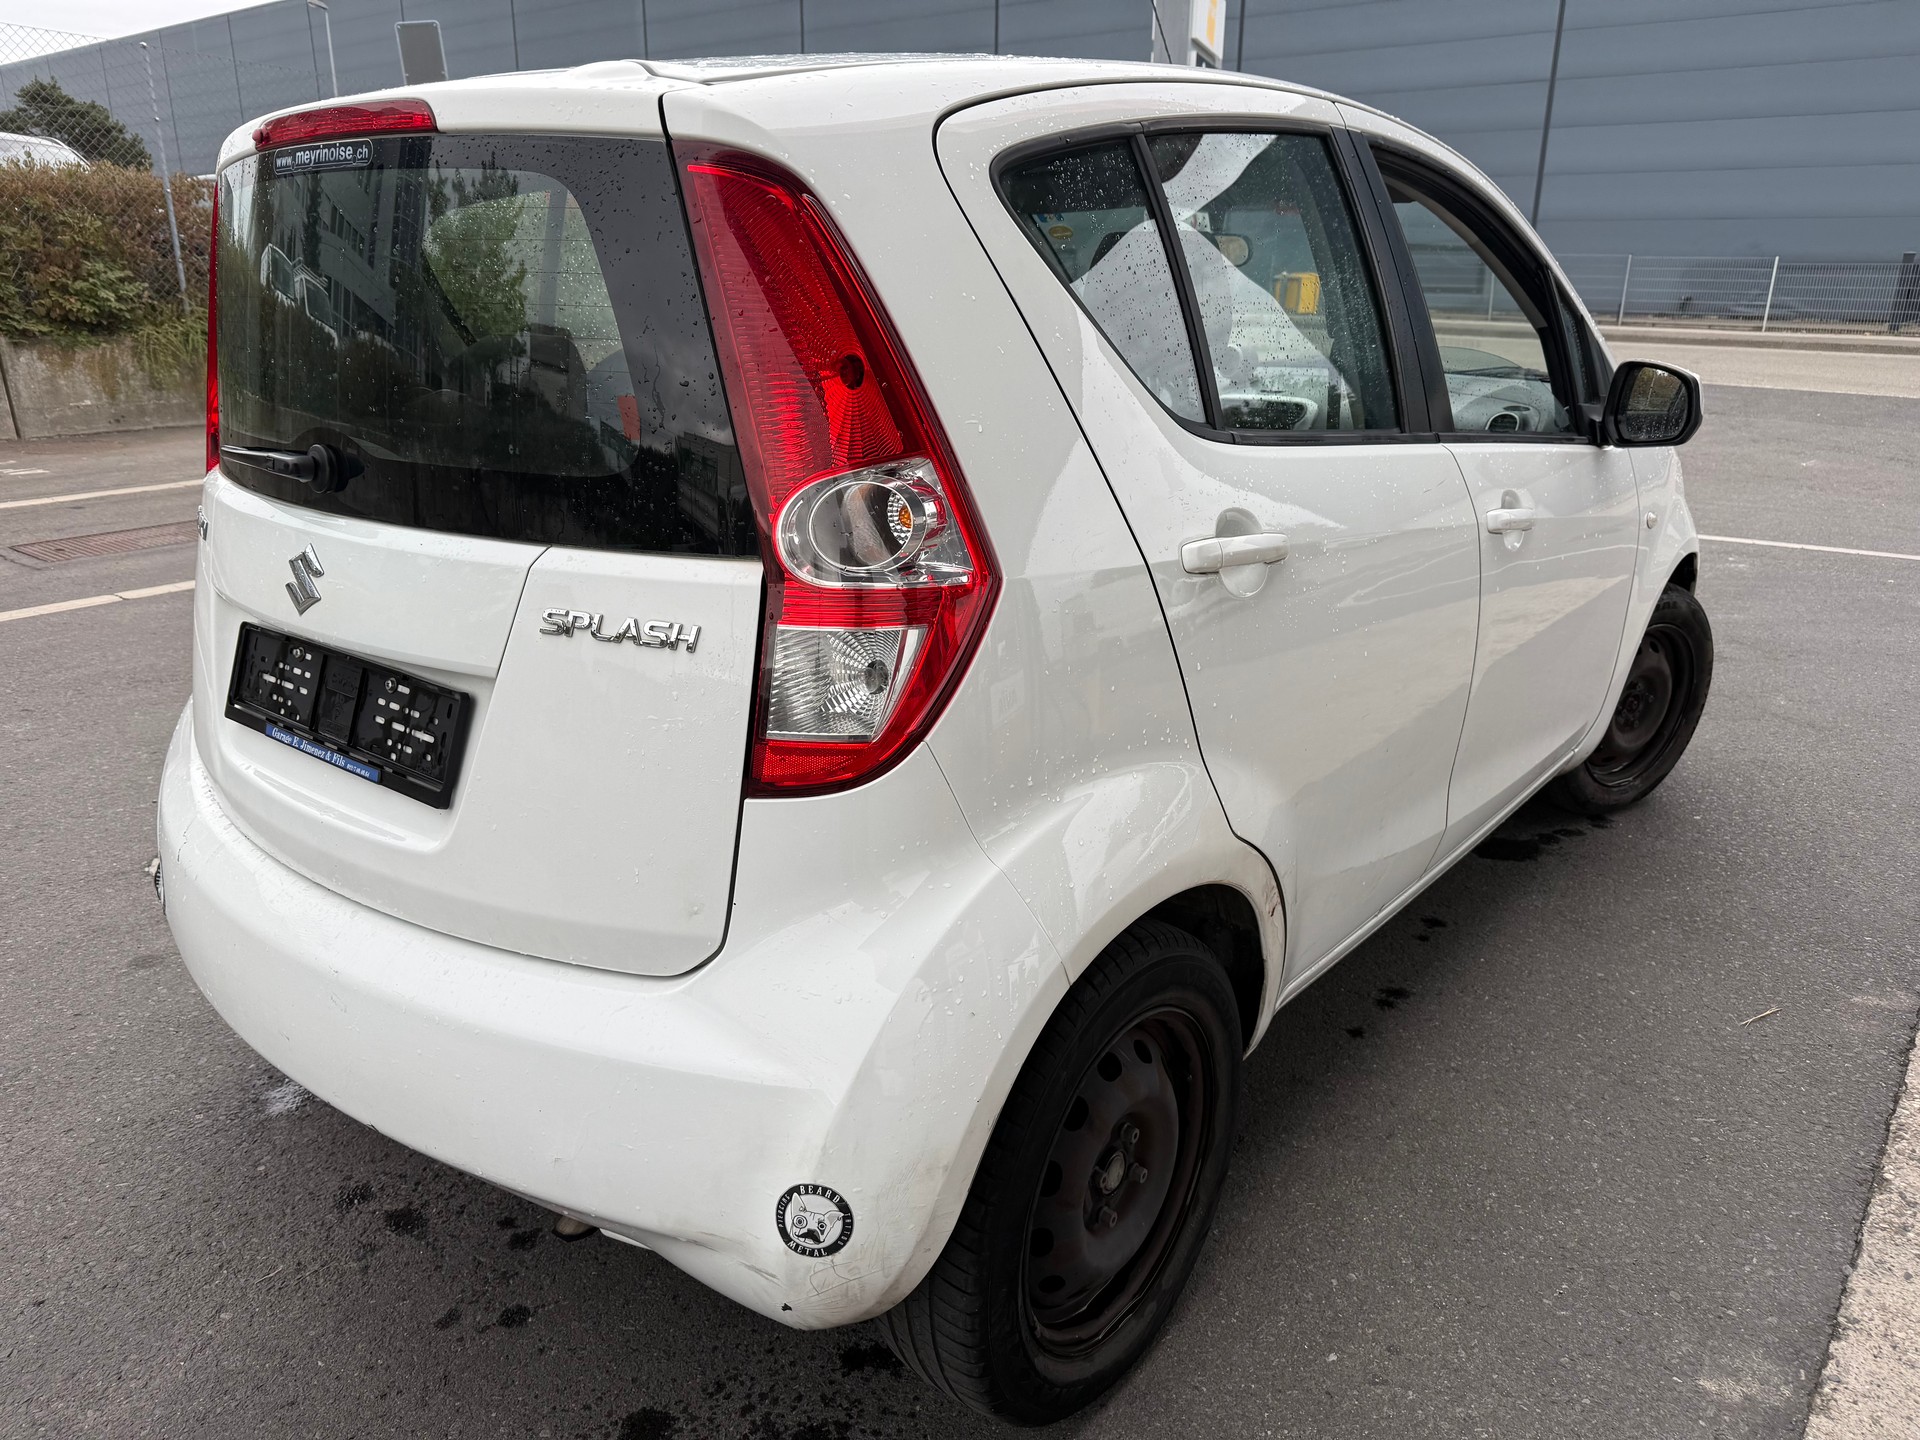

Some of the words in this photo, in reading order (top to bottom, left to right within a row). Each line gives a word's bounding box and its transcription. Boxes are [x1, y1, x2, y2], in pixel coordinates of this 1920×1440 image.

[539, 607, 701, 653] SPLASH
[272, 727, 292, 743] Garage
[300, 740, 325, 759] Jimenez
[325, 751, 332, 761] &
[332, 753, 346, 767] Fils
[799, 1185, 841, 1203] BEARD
[787, 1240, 828, 1257] METAL
